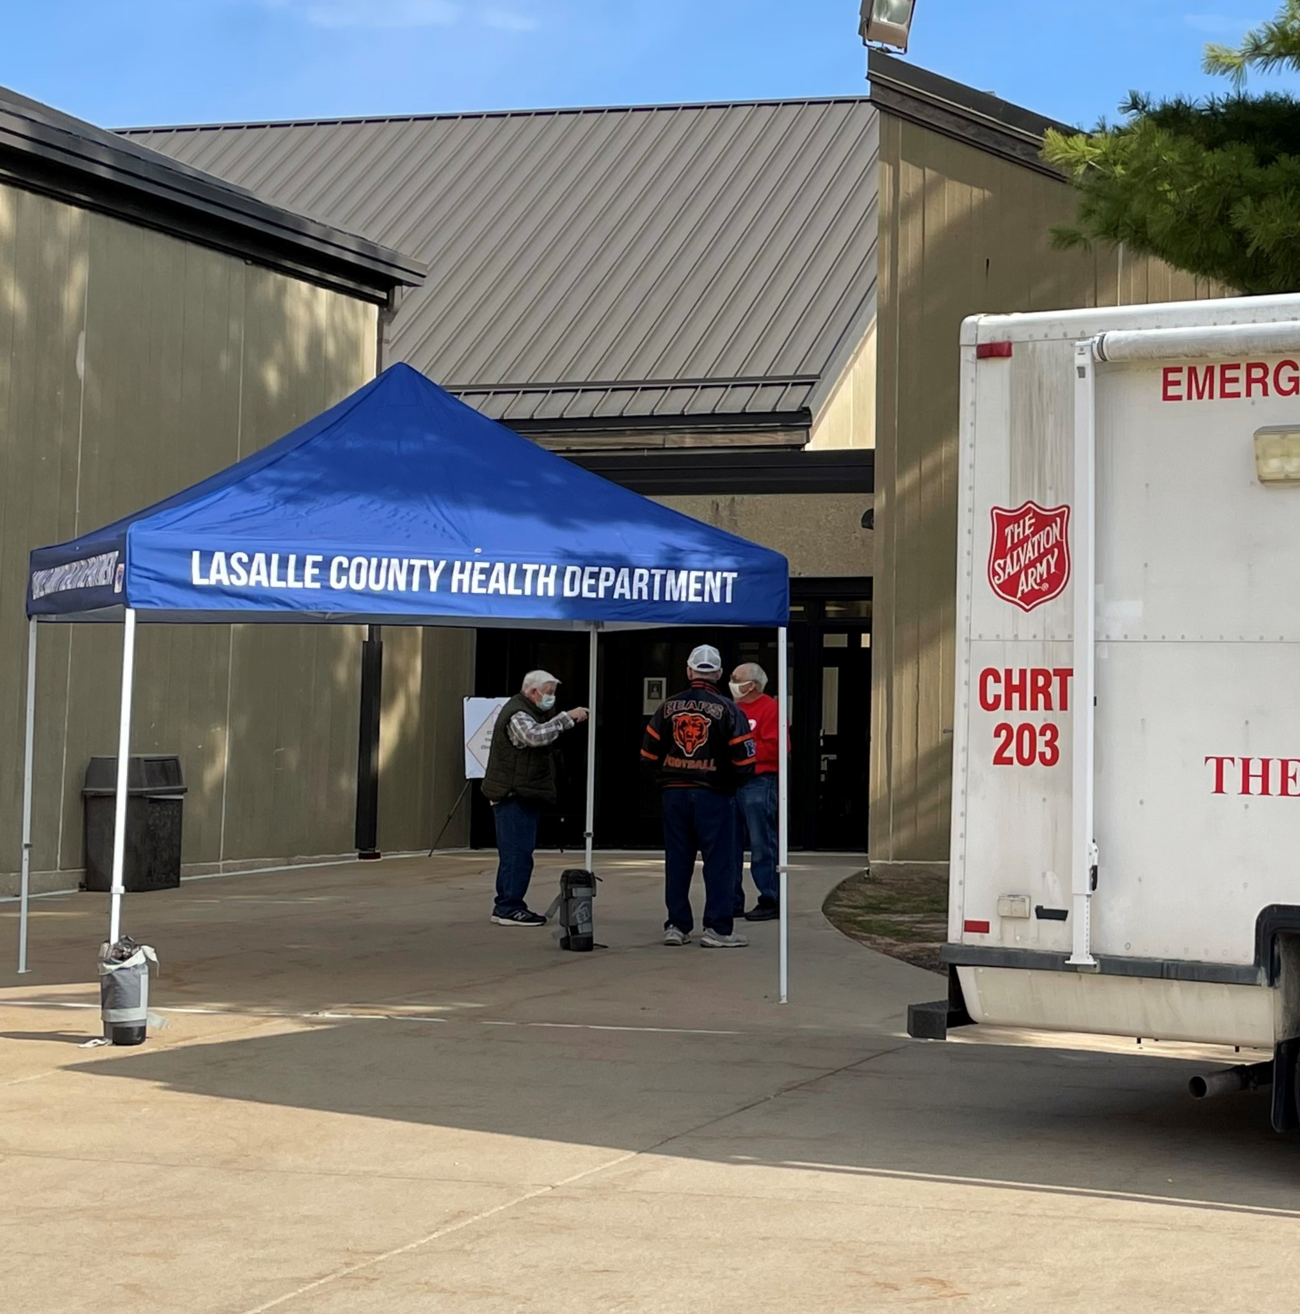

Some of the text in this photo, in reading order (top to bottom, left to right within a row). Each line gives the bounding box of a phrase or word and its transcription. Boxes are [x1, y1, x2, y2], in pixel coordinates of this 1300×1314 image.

[994, 517, 1061, 585] SALVATION
[1005, 511, 1036, 551] THE
[191, 550, 738, 604] LASALLE COUNTY HEALTH DEPARTMENT
[1016, 547, 1059, 599] ARMY
[663, 699, 724, 720] BEARS
[979, 667, 1073, 712] CHRT
[663, 754, 717, 772] FOOTBALL
[992, 722, 1060, 767] 203
